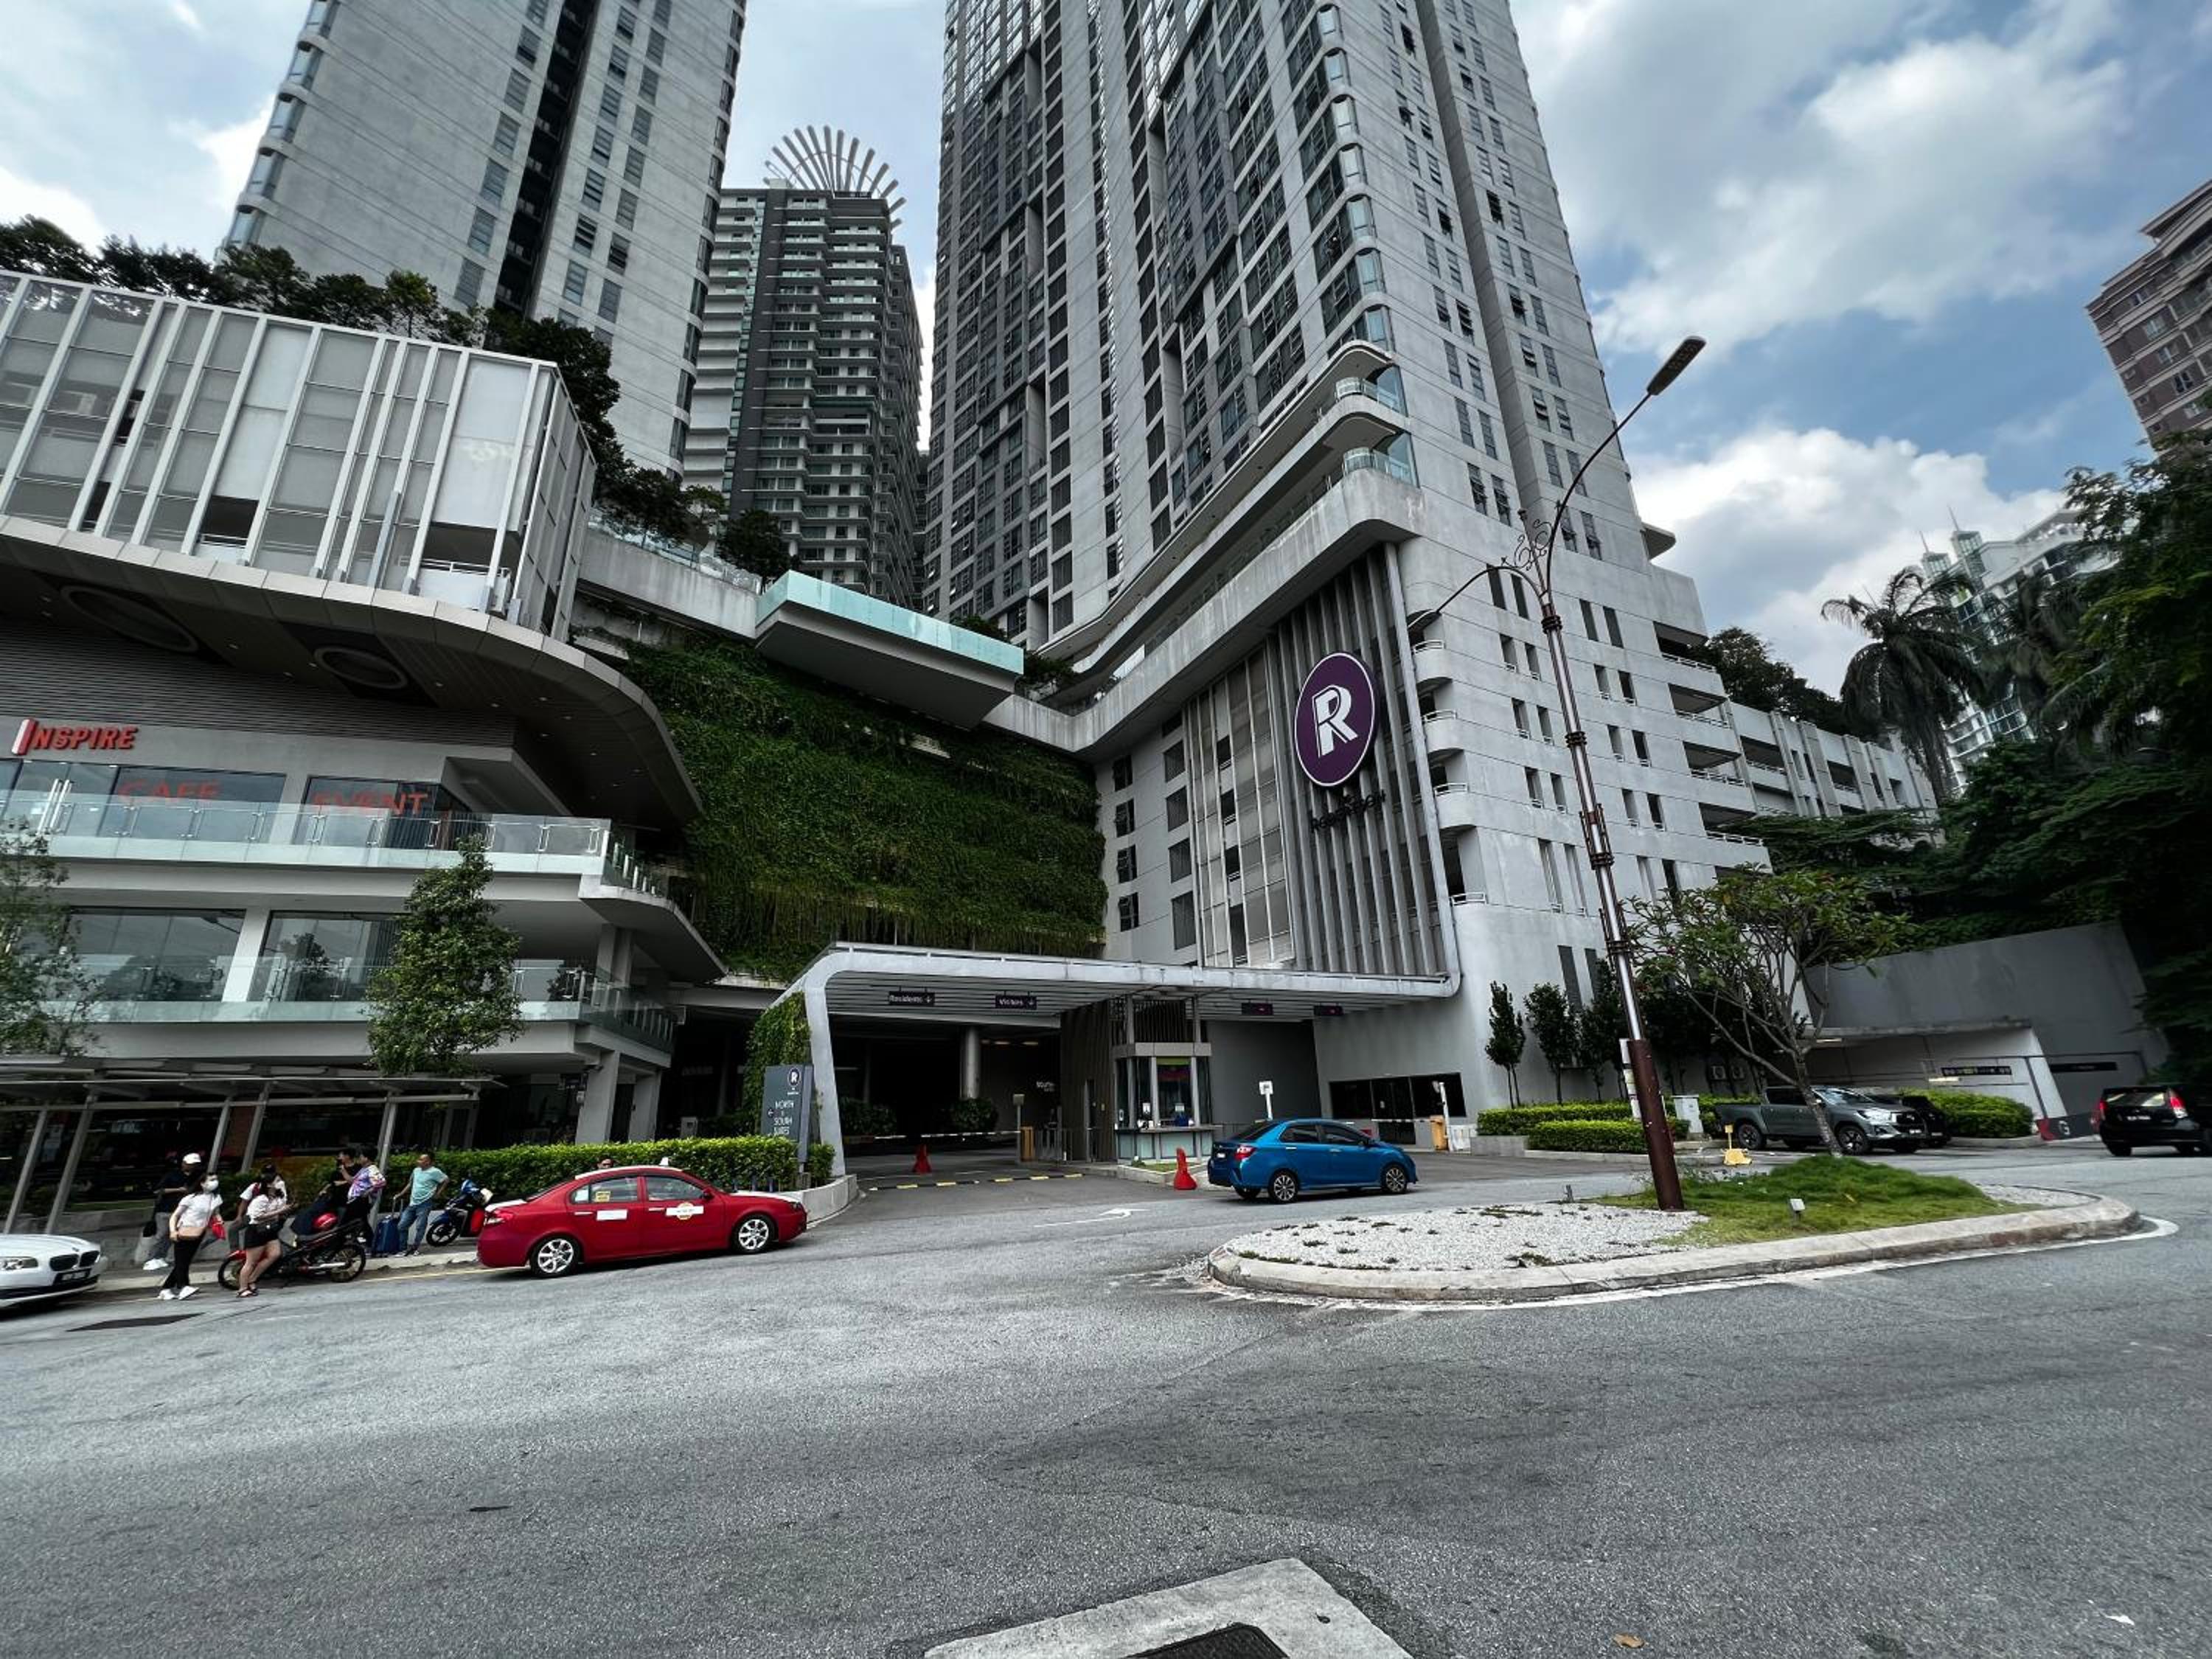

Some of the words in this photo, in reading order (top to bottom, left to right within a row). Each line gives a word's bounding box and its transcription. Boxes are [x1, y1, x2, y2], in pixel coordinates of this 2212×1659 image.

[11, 718, 139, 756] INSPIRE
[1312, 684, 1358, 759] R
[116, 778, 223, 802] CAFE
[312, 791, 429, 816] EVENT
